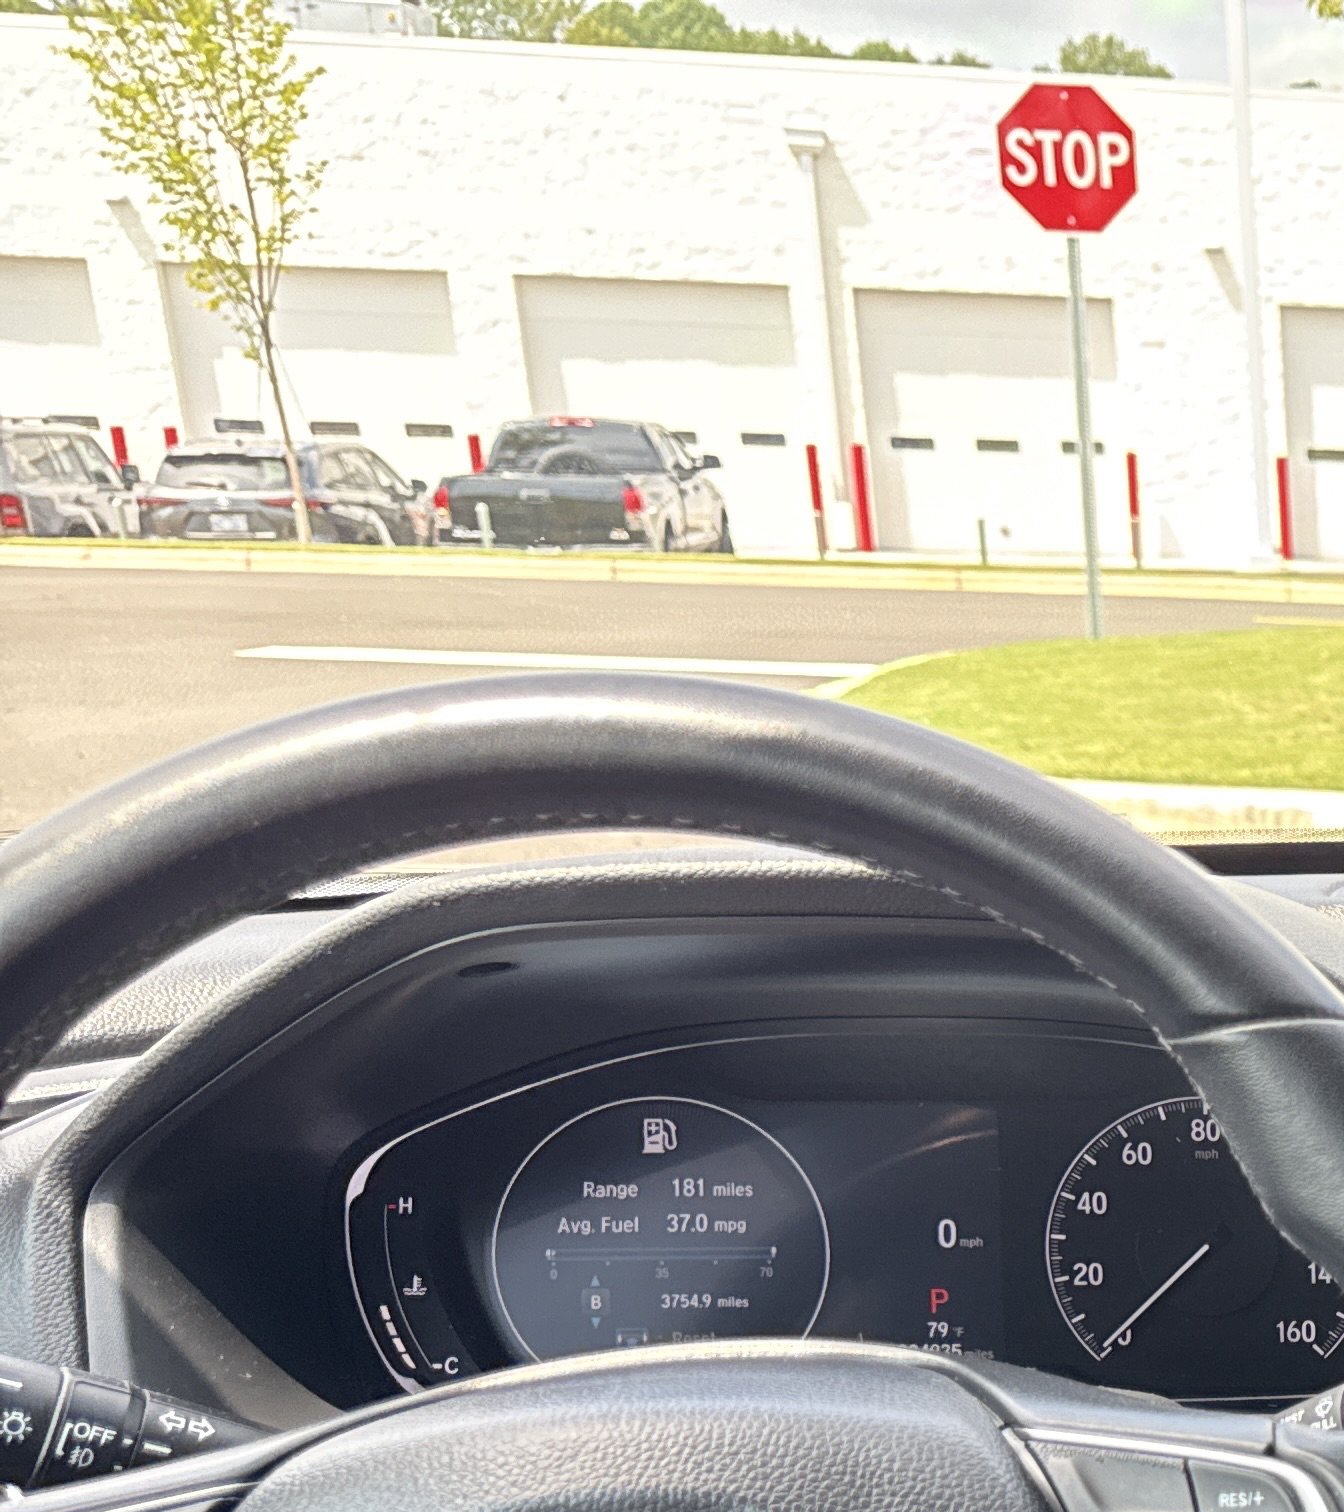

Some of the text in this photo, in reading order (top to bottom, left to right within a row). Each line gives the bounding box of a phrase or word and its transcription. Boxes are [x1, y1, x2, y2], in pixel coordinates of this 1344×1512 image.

[1005, 127, 1131, 190] STOP
[1190, 1119, 1220, 1142] 80
[1121, 1142, 1152, 1166] 60
[1195, 1148, 1219, 1160] mph
[583, 1178, 753, 1200] Range 181 miles
[398, 1196, 413, 1215] H
[1076, 1191, 1107, 1215] 40
[557, 1213, 747, 1236] Avg. Fuel 37.0 mpg
[938, 1219, 984, 1249] 0 mph
[1072, 1262, 1103, 1287] 20
[1308, 1262, 1333, 1285] 14
[590, 1294, 602, 1310] B
[660, 1293, 749, 1309] 3754.9 miles
[929, 1287, 950, 1314] P
[925, 1321, 949, 1338] 79
[1275, 1320, 1316, 1343] 160
[443, 1356, 459, 1374] C
[73, 1421, 118, 1447] OFF
